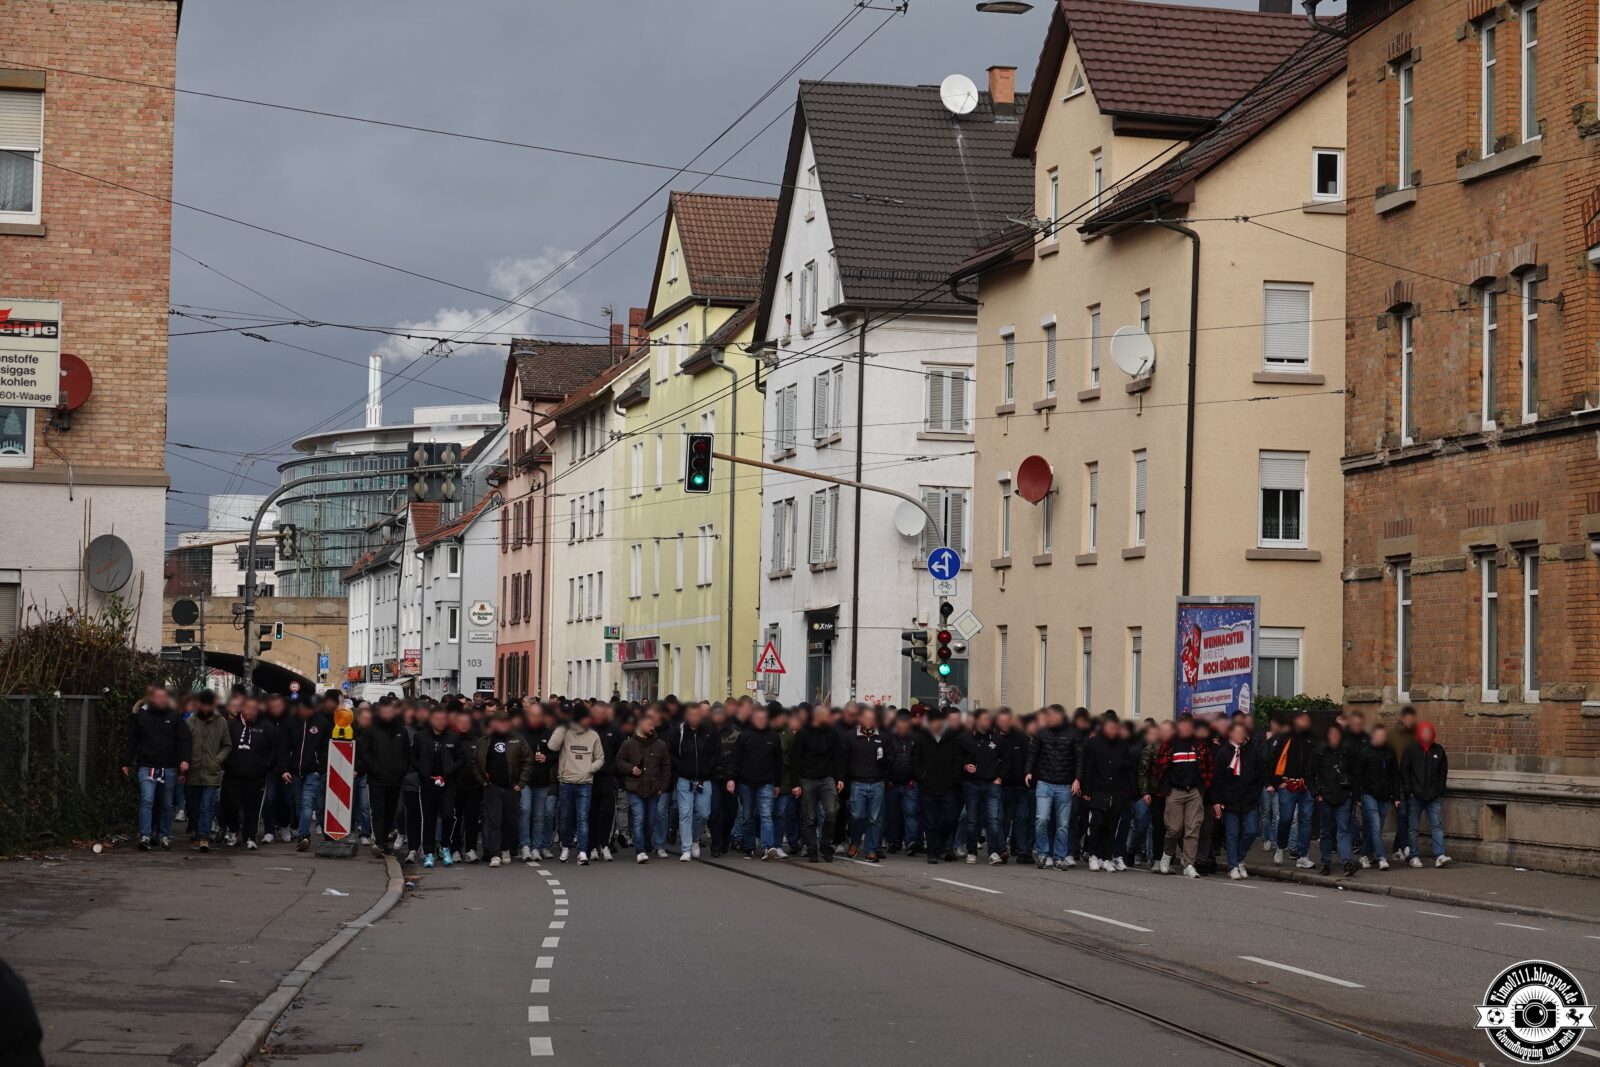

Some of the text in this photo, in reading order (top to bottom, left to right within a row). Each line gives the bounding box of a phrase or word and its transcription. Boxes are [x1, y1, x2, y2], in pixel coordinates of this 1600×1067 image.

[1, 365, 36, 376] siggas
[1, 377, 37, 387] kohlen
[1203, 631, 1244, 650] WEIHNACHTEN
[467, 658, 482, 667] 103
[1203, 660, 1219, 675] NOCH
